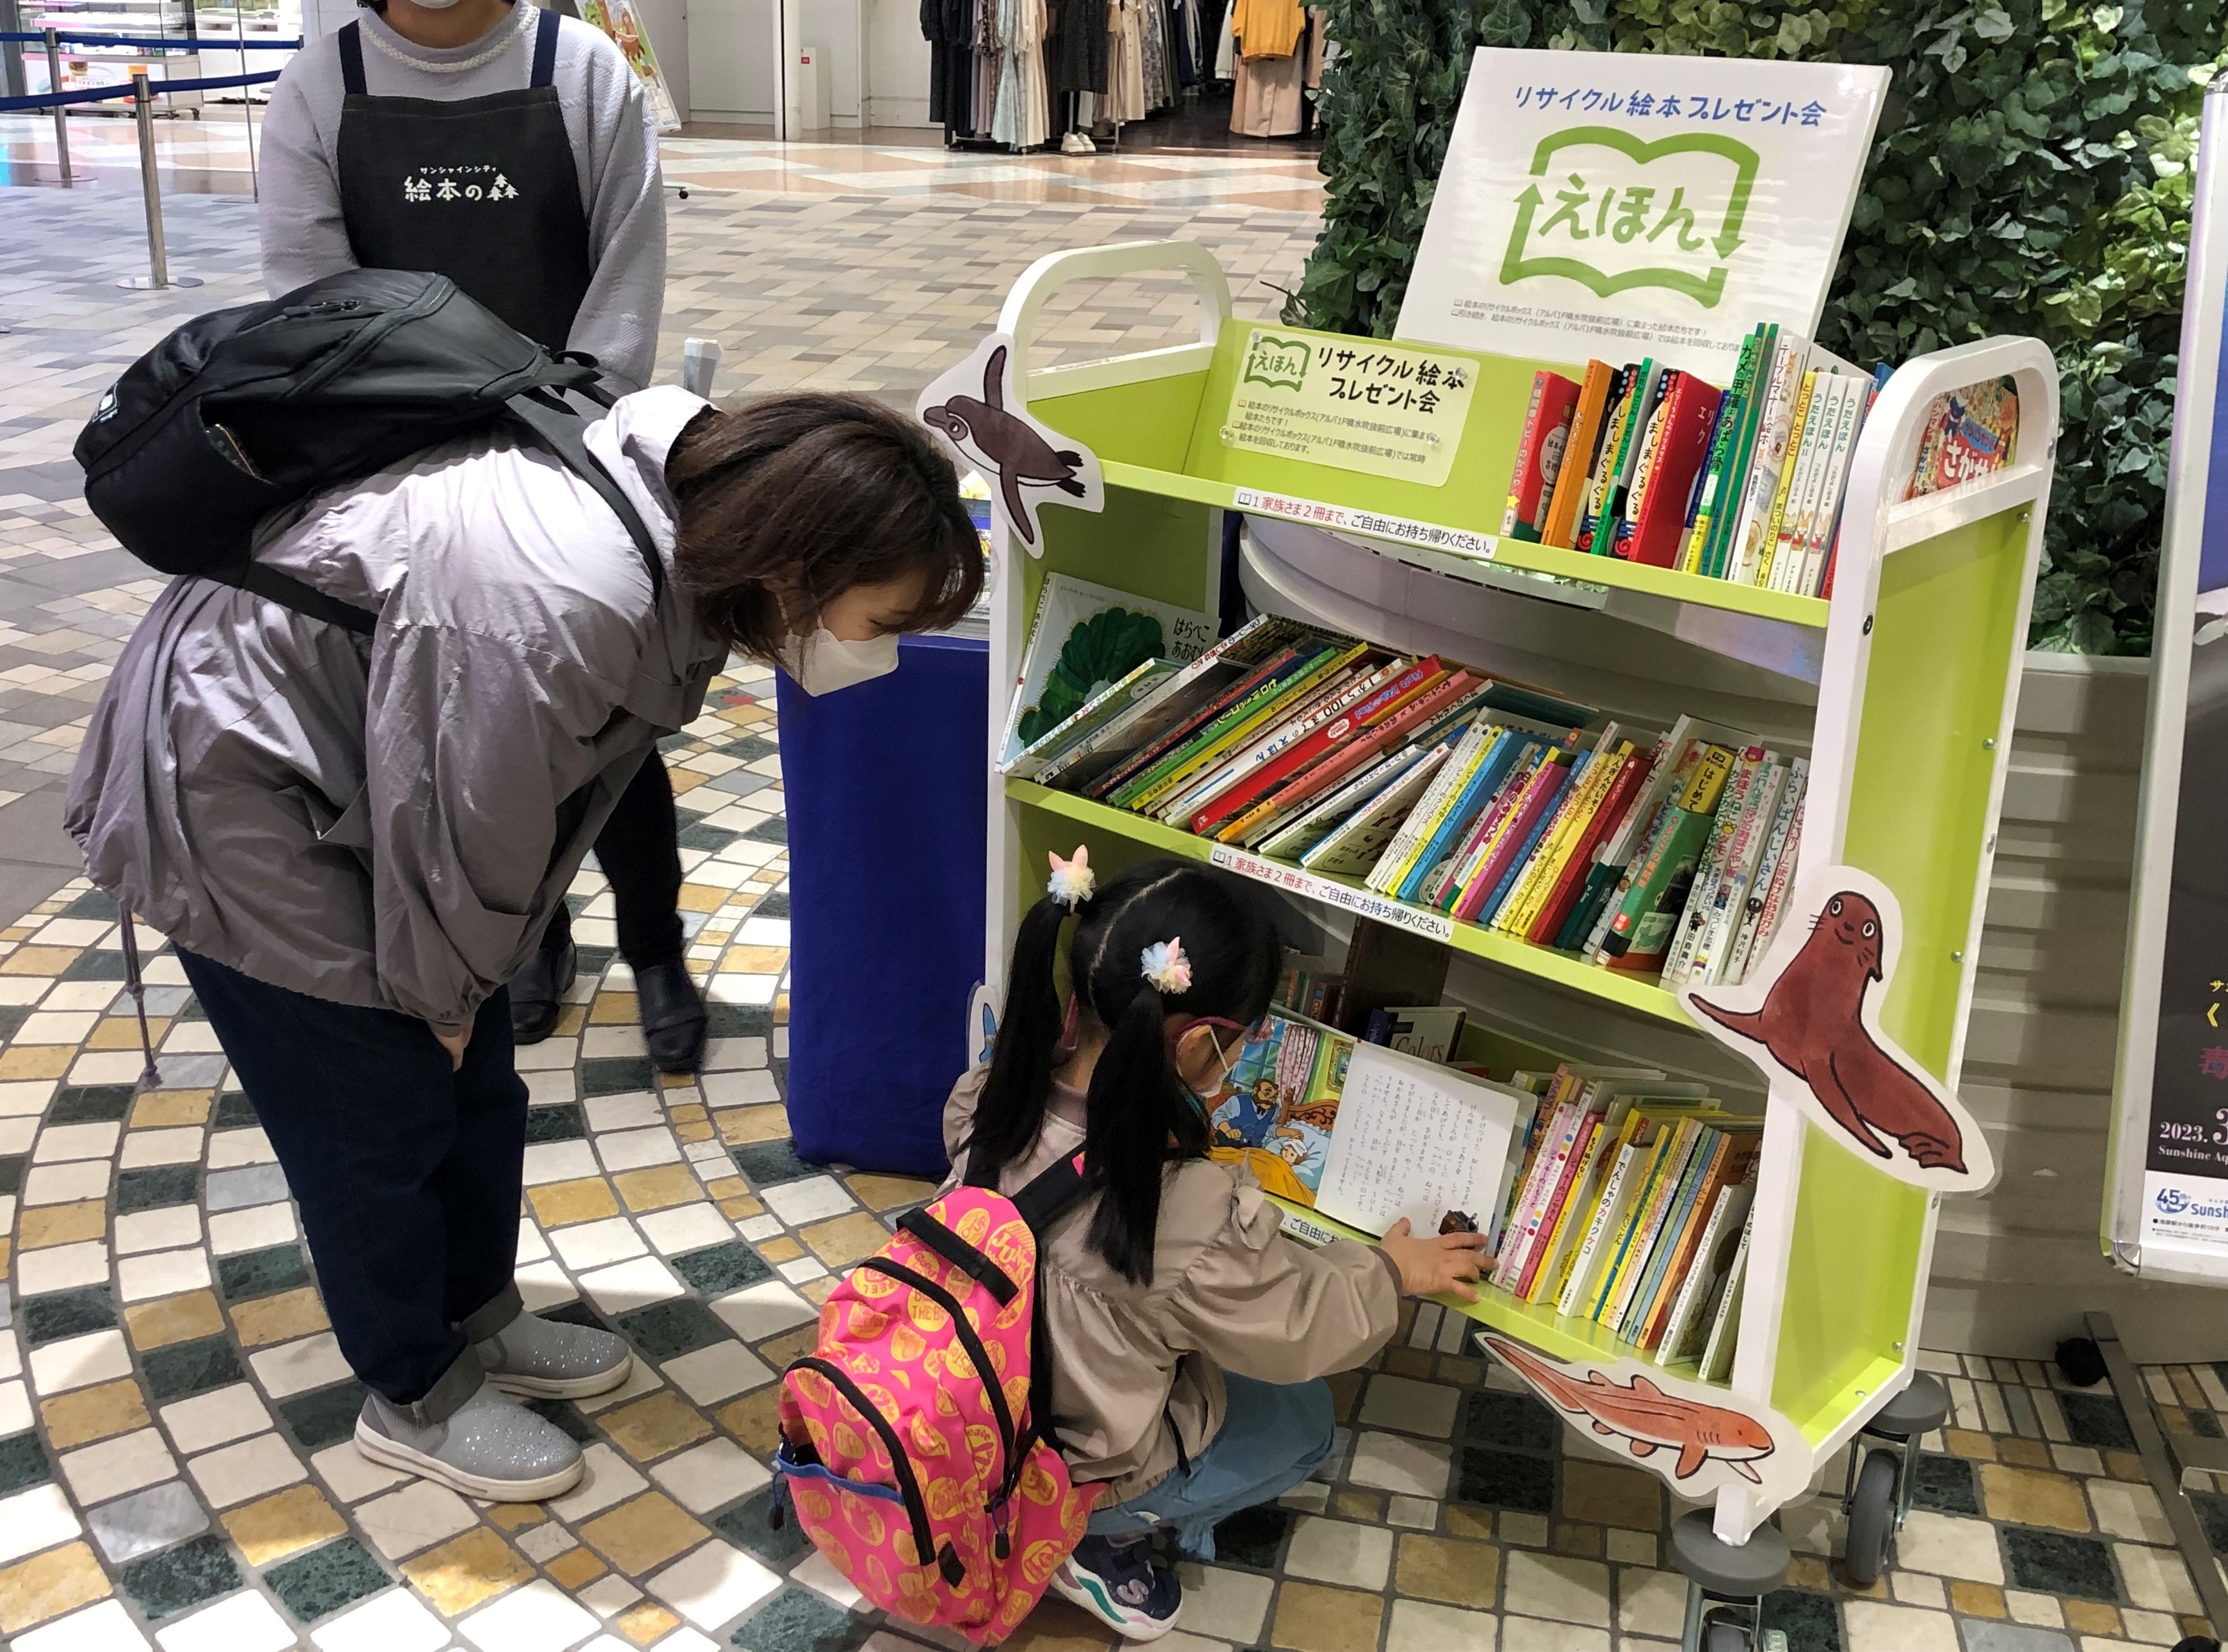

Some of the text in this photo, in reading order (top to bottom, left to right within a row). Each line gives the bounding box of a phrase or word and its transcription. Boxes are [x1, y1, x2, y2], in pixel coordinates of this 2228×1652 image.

[1515, 86, 1828, 127] リサイクル絵本プレゼント会
[420, 165, 497, 174] サンシャインシティ
[1538, 173, 1706, 251] えほん
[1254, 351, 1298, 376] えほん
[1330, 376, 1440, 414] プレゼント会
[1709, 344, 1753, 472] カメの甲羅はあばら骨
[1758, 343, 1790, 446] テーブルマナーの絵本
[1787, 383, 1811, 457] とっとこ とっとこ
[1802, 392, 1824, 448] うたえほん
[1817, 395, 1840, 451] うたえほん
[1656, 387, 1683, 464] エリーちゃんのクリスマス
[1835, 397, 1857, 453] うたえほん
[1588, 404, 1628, 511] しましまぐるぐる
[1626, 408, 1666, 515] しましまぐるぐる
[1763, 502, 1782, 565] まついのりこ さく
[1174, 617, 1211, 643] はらぺこ
[1428, 688, 1478, 725] ぼくのくれよん
[1254, 735, 1290, 764] えほん
[1422, 765, 1464, 826] ジャッキーのクリスマス
[1433, 768, 1474, 825] ジャッキーのしんゆう
[1586, 751, 1626, 815] ぺんぎんたいそう
[1711, 767, 1753, 866] まほうねこ ダモン
[1754, 765, 1806, 892] ふらいぱんじいさん
[1522, 854, 1546, 889] まついのりこ
[1732, 932, 1749, 964] 神沢利子
[1529, 1149, 1557, 1208] ジャッキーのいもうと
[2158, 1144, 2211, 1161] Sunshine
[1546, 1157, 1577, 1222] ジャッキーのパンやさん
[1581, 1160, 1627, 1256] でんしゃのカキクケコ
